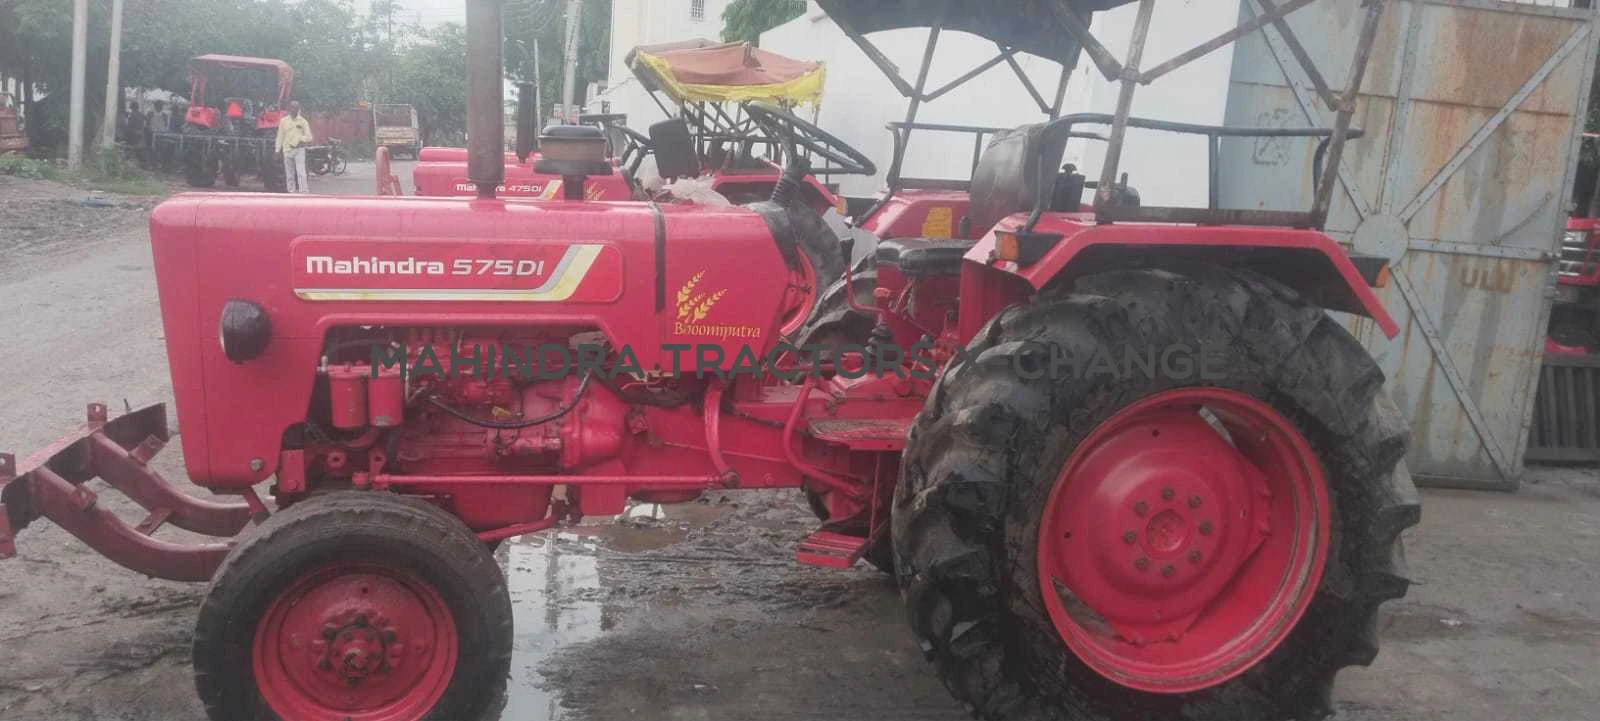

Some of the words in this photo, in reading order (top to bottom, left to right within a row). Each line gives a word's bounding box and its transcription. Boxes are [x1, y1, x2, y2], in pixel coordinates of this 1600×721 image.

[456, 183, 506, 192] Mahra
[306, 255, 445, 275] Mahindra
[451, 259, 545, 276] 575DI
